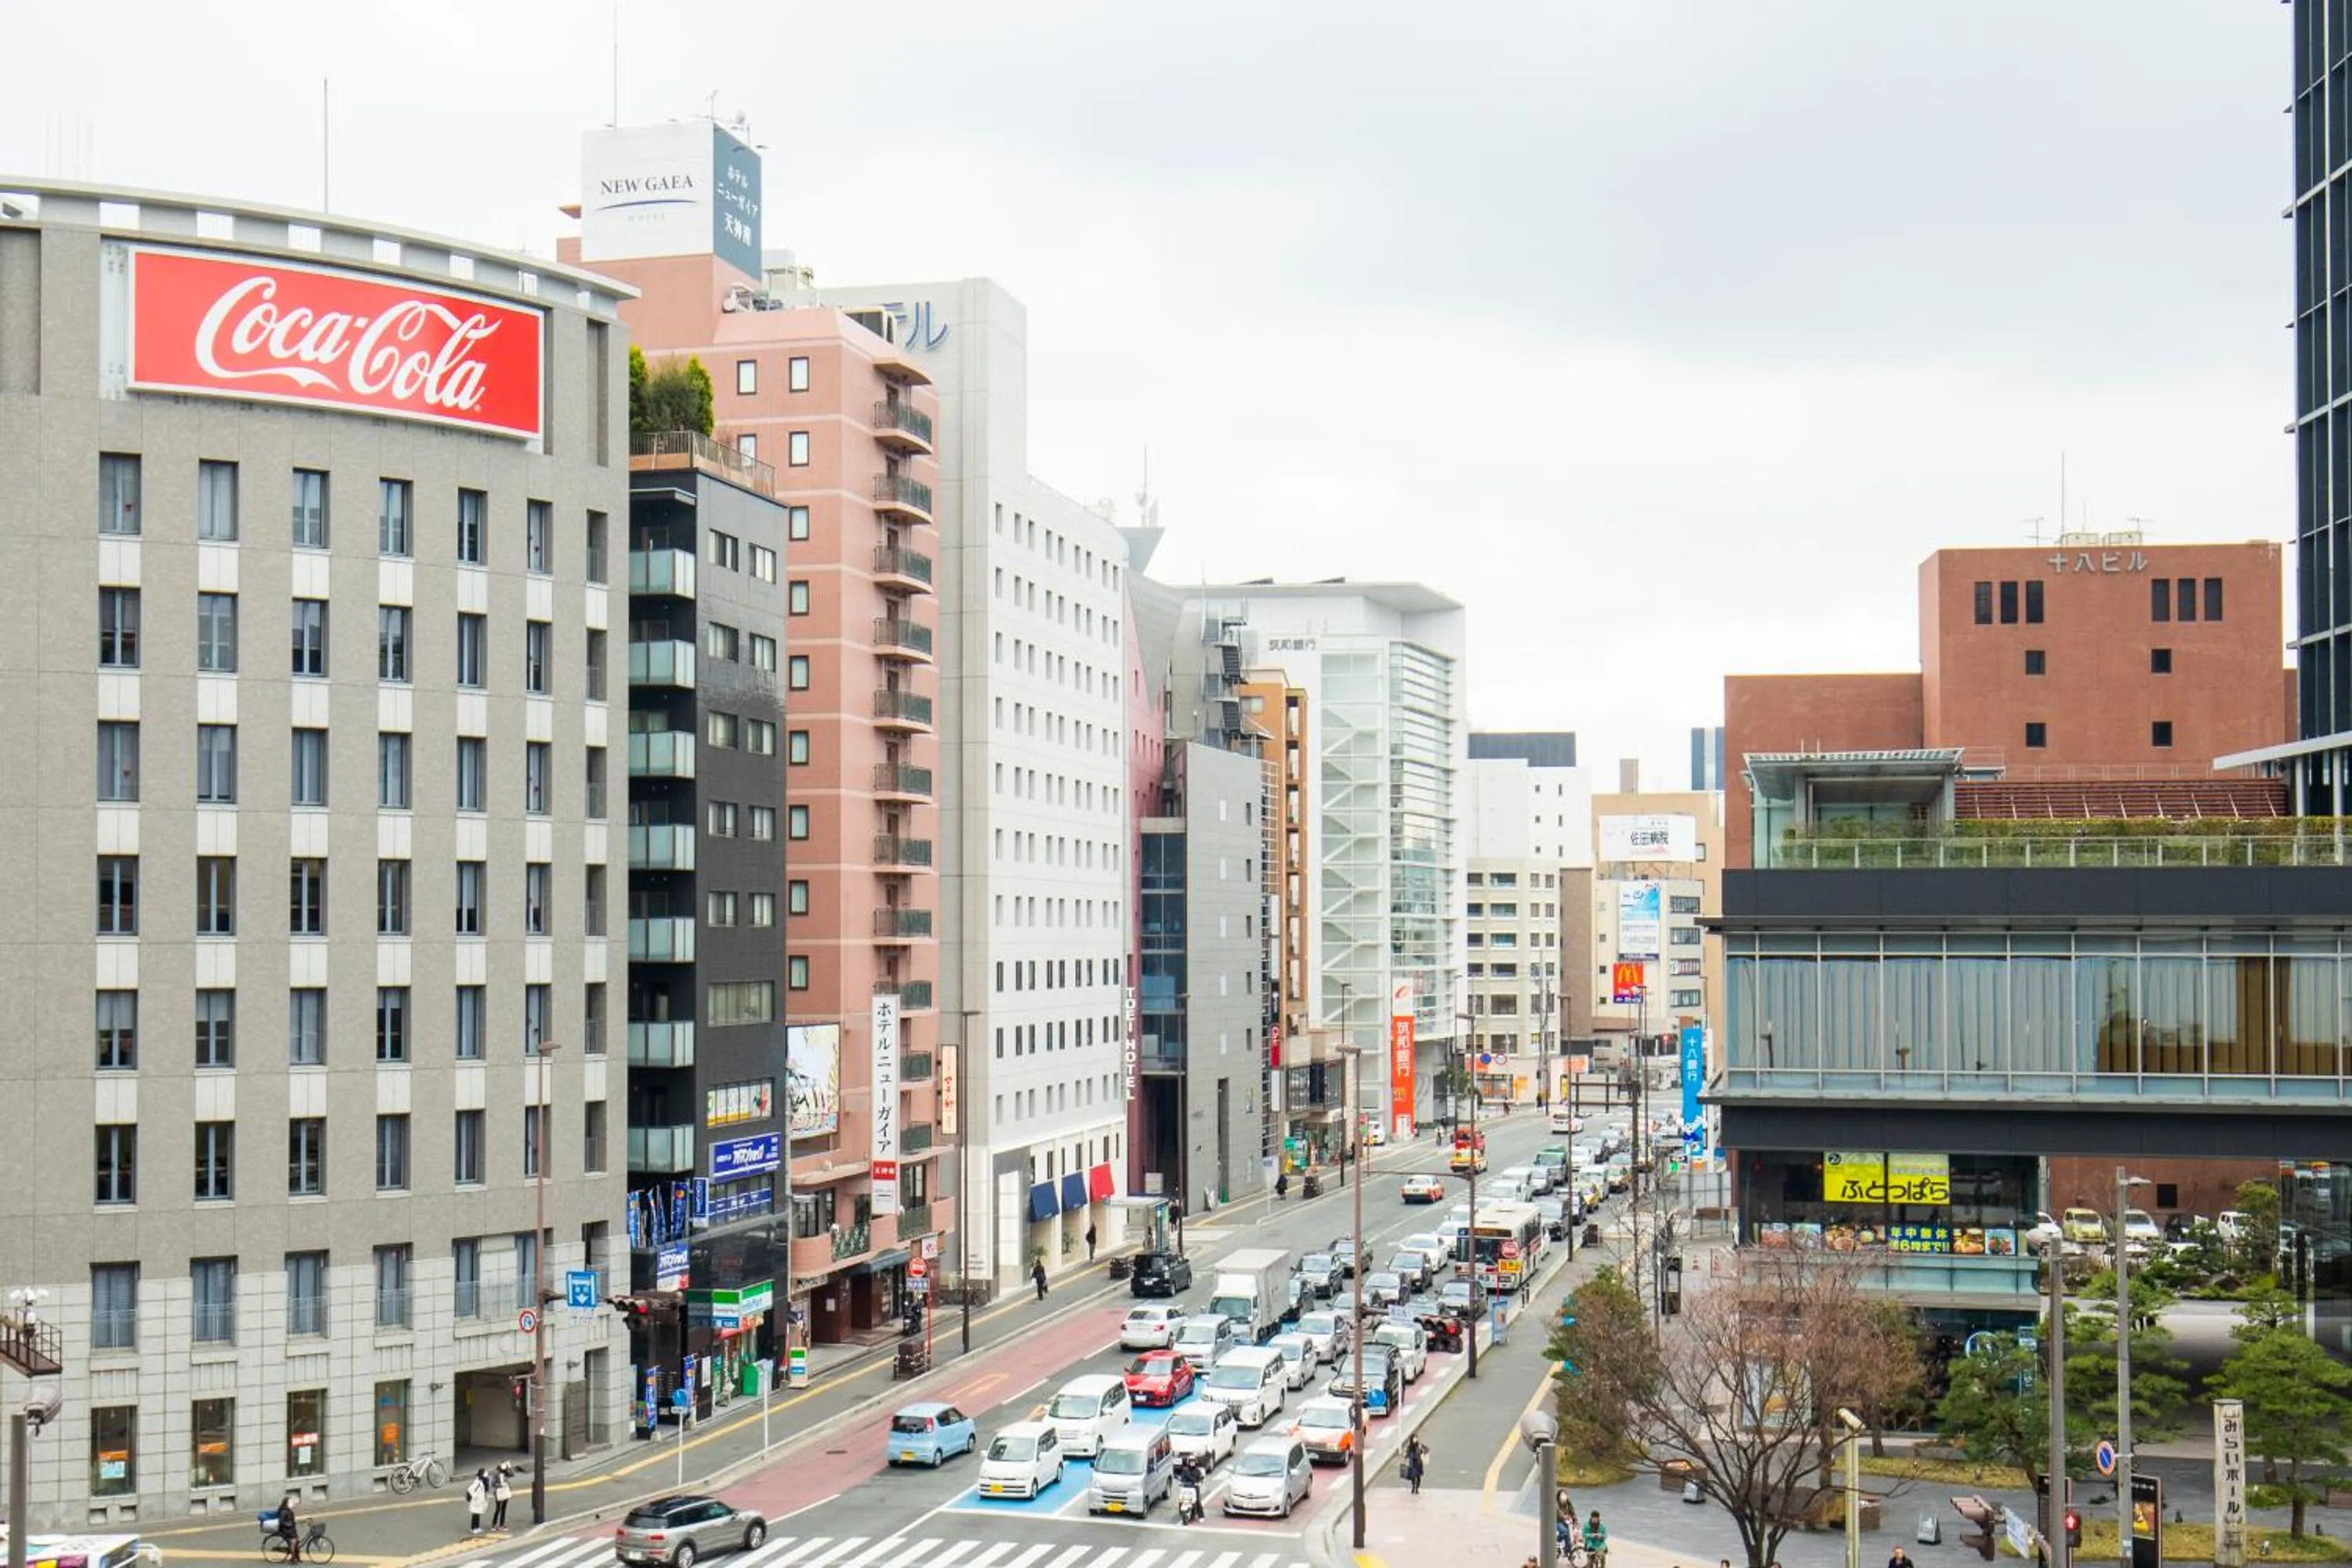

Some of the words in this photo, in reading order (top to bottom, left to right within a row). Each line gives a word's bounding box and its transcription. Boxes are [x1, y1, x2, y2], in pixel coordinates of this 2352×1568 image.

[601, 179, 641, 194] NEW
[644, 174, 694, 191] GAEA
[195, 276, 503, 412] Coca-Cola
[2047, 551, 2148, 573] 十八ビル
[1125, 987, 1136, 1033] TOEI
[877, 1002, 892, 1155] ホテルニューガイア
[1125, 1039, 1136, 1100] HOTEL
[2223, 1419, 2241, 1514] みらいホール
